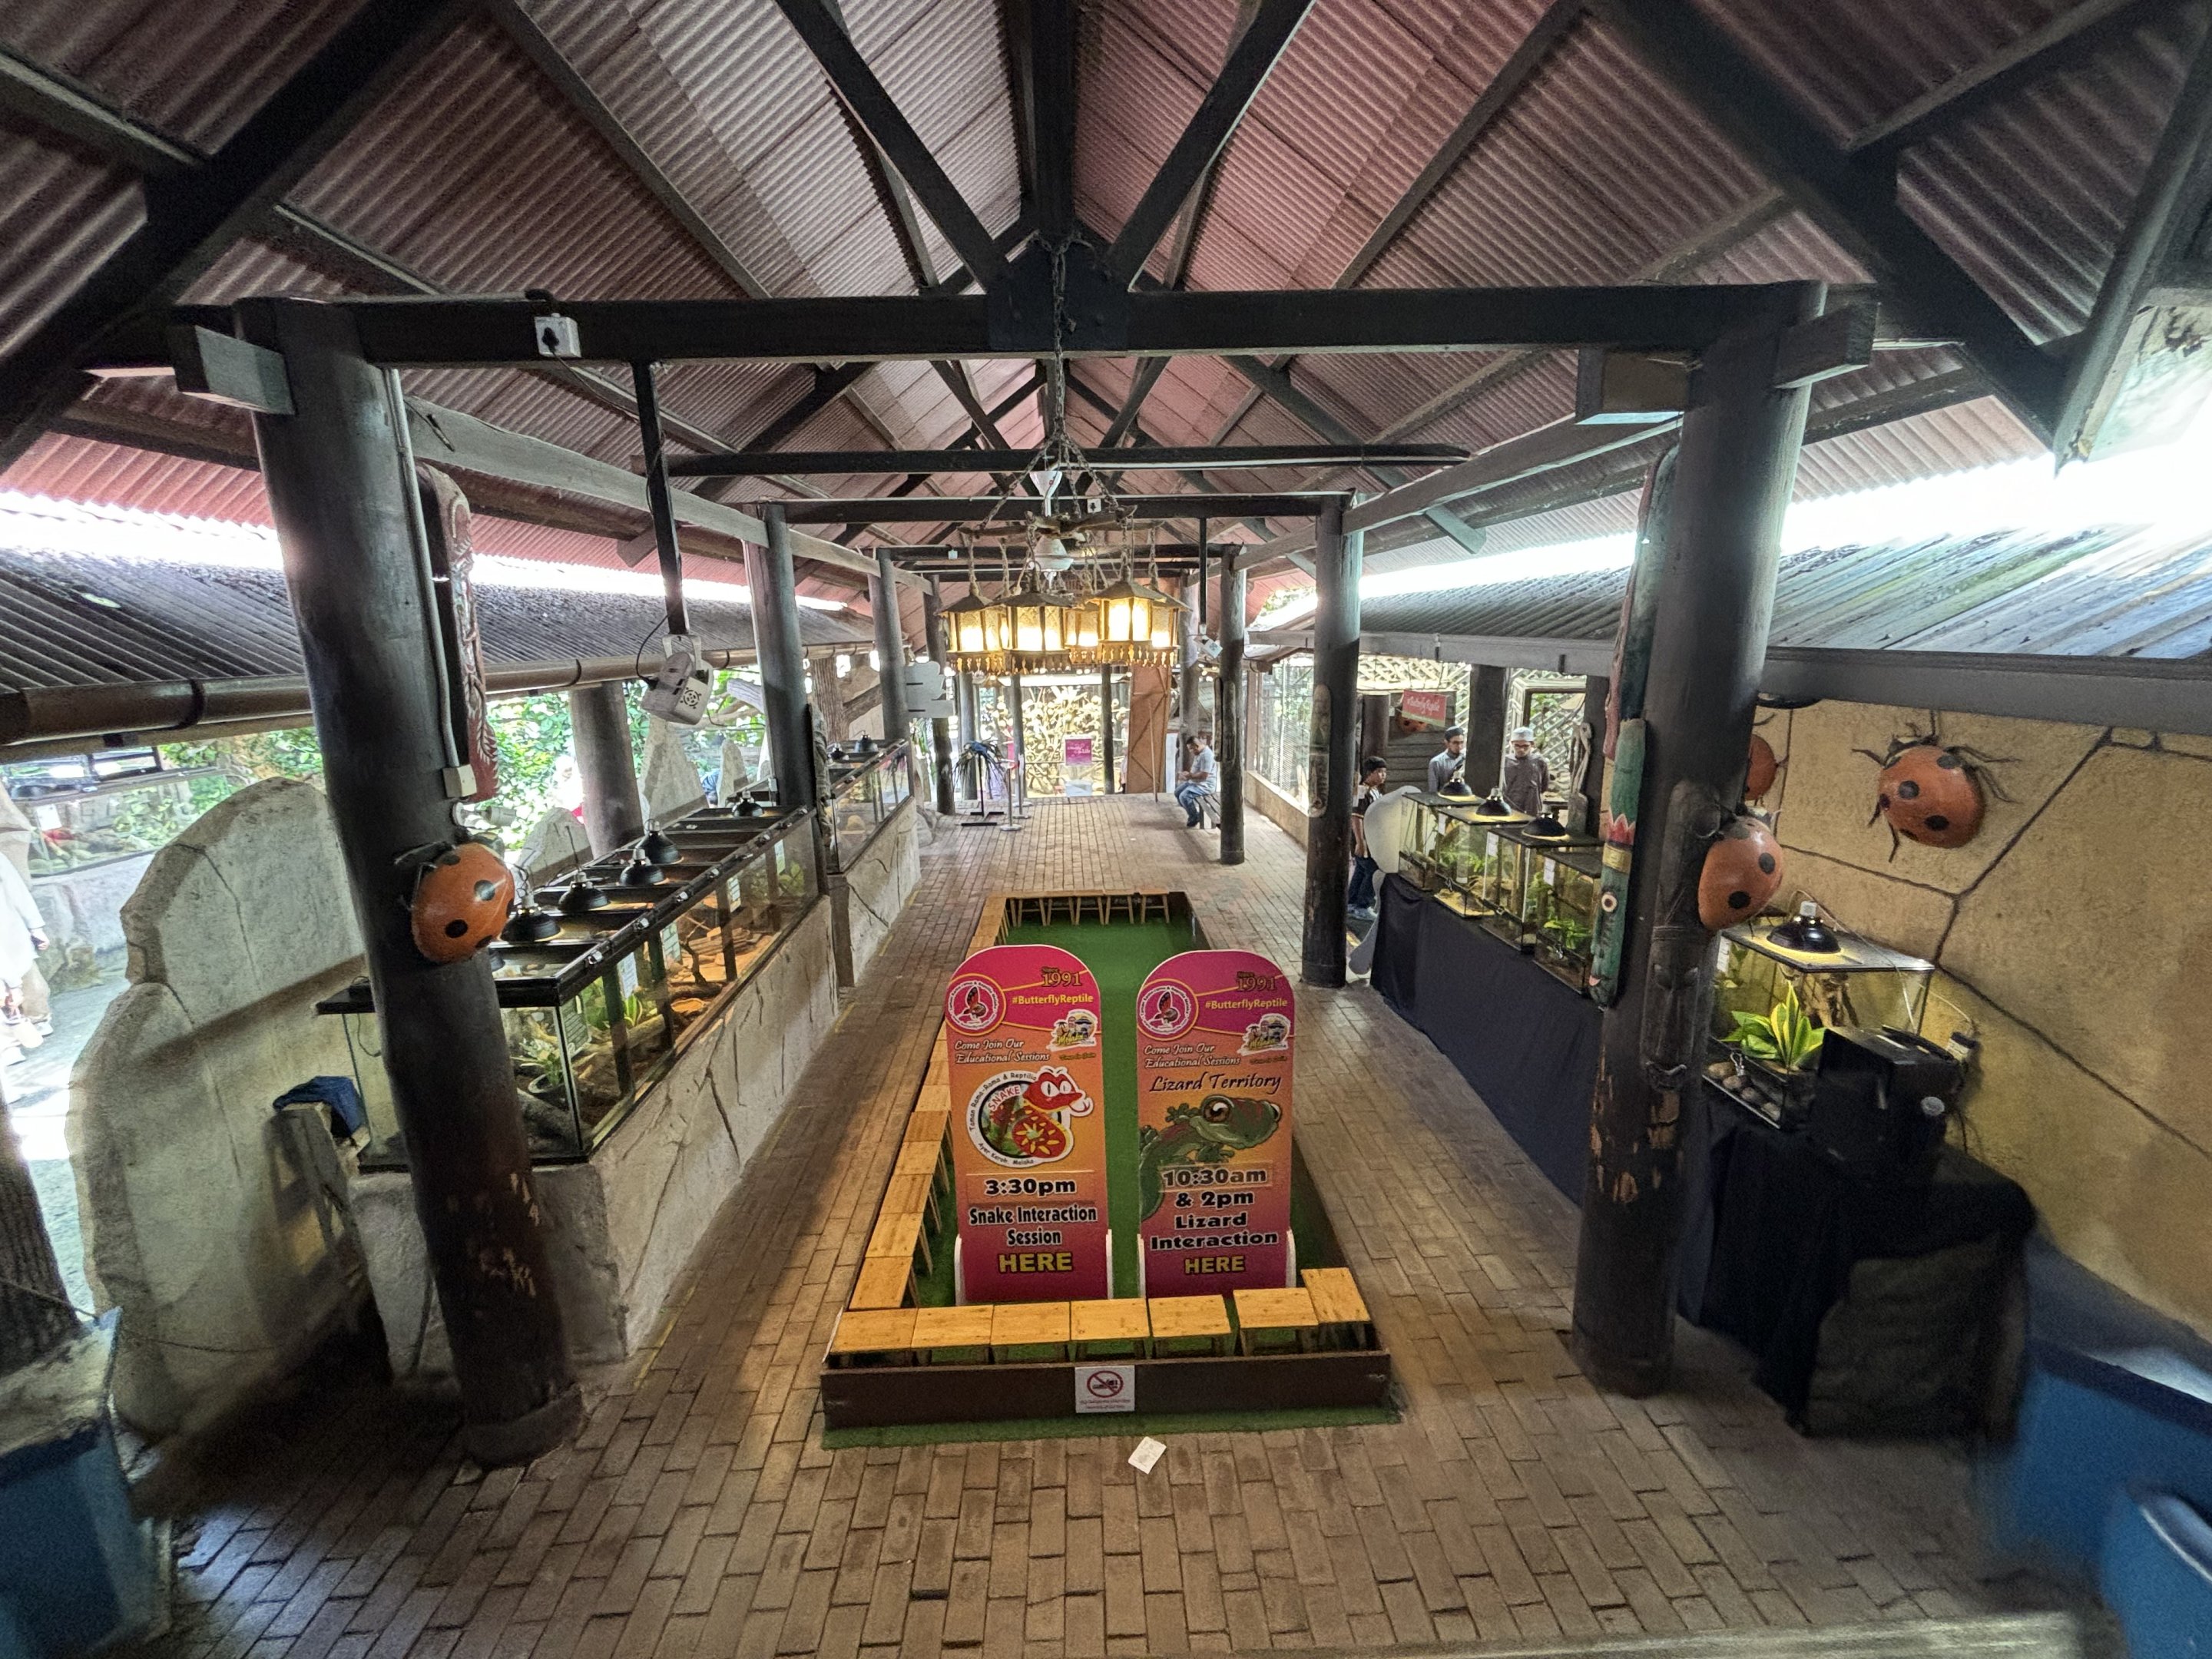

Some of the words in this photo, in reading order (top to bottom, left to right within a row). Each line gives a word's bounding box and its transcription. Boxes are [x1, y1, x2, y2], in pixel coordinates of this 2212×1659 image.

[1042, 972, 1081, 987] 1991
[1237, 976, 1276, 992] 1991
[1012, 994, 1093, 1005] #ButterflyReptile
[1205, 998, 1287, 1010] #ButterflyReptile
[954, 1040, 980, 1051] Come
[982, 1038, 1002, 1050] Join
[1005, 1038, 1024, 1048] Our
[1144, 1045, 1170, 1055] Come
[1171, 1044, 1193, 1055] Join
[1196, 1043, 1214, 1053] Our
[955, 1051, 1012, 1064] Educational
[1014, 1051, 1050, 1062] Sessions
[1144, 1056, 1201, 1069] Educational
[1204, 1056, 1240, 1067] Sessions
[1150, 1071, 1207, 1092] Lizard
[1209, 1073, 1282, 1094] Territory
[988, 1085, 1021, 1111] SNAKE
[1162, 1169, 1267, 1187] 10:30am
[985, 1178, 1076, 1197] 3:30pm
[1176, 1193, 1192, 1207] &
[1201, 1191, 1254, 1209] 2pm
[969, 1206, 1013, 1225] Snake
[1018, 1204, 1097, 1223] Interaction
[1175, 1211, 1247, 1229] Lizard
[1007, 1227, 1061, 1246] Session
[1151, 1230, 1278, 1250] Interaction
[998, 1252, 1072, 1273] HERE
[1184, 1255, 1246, 1274] HERE
